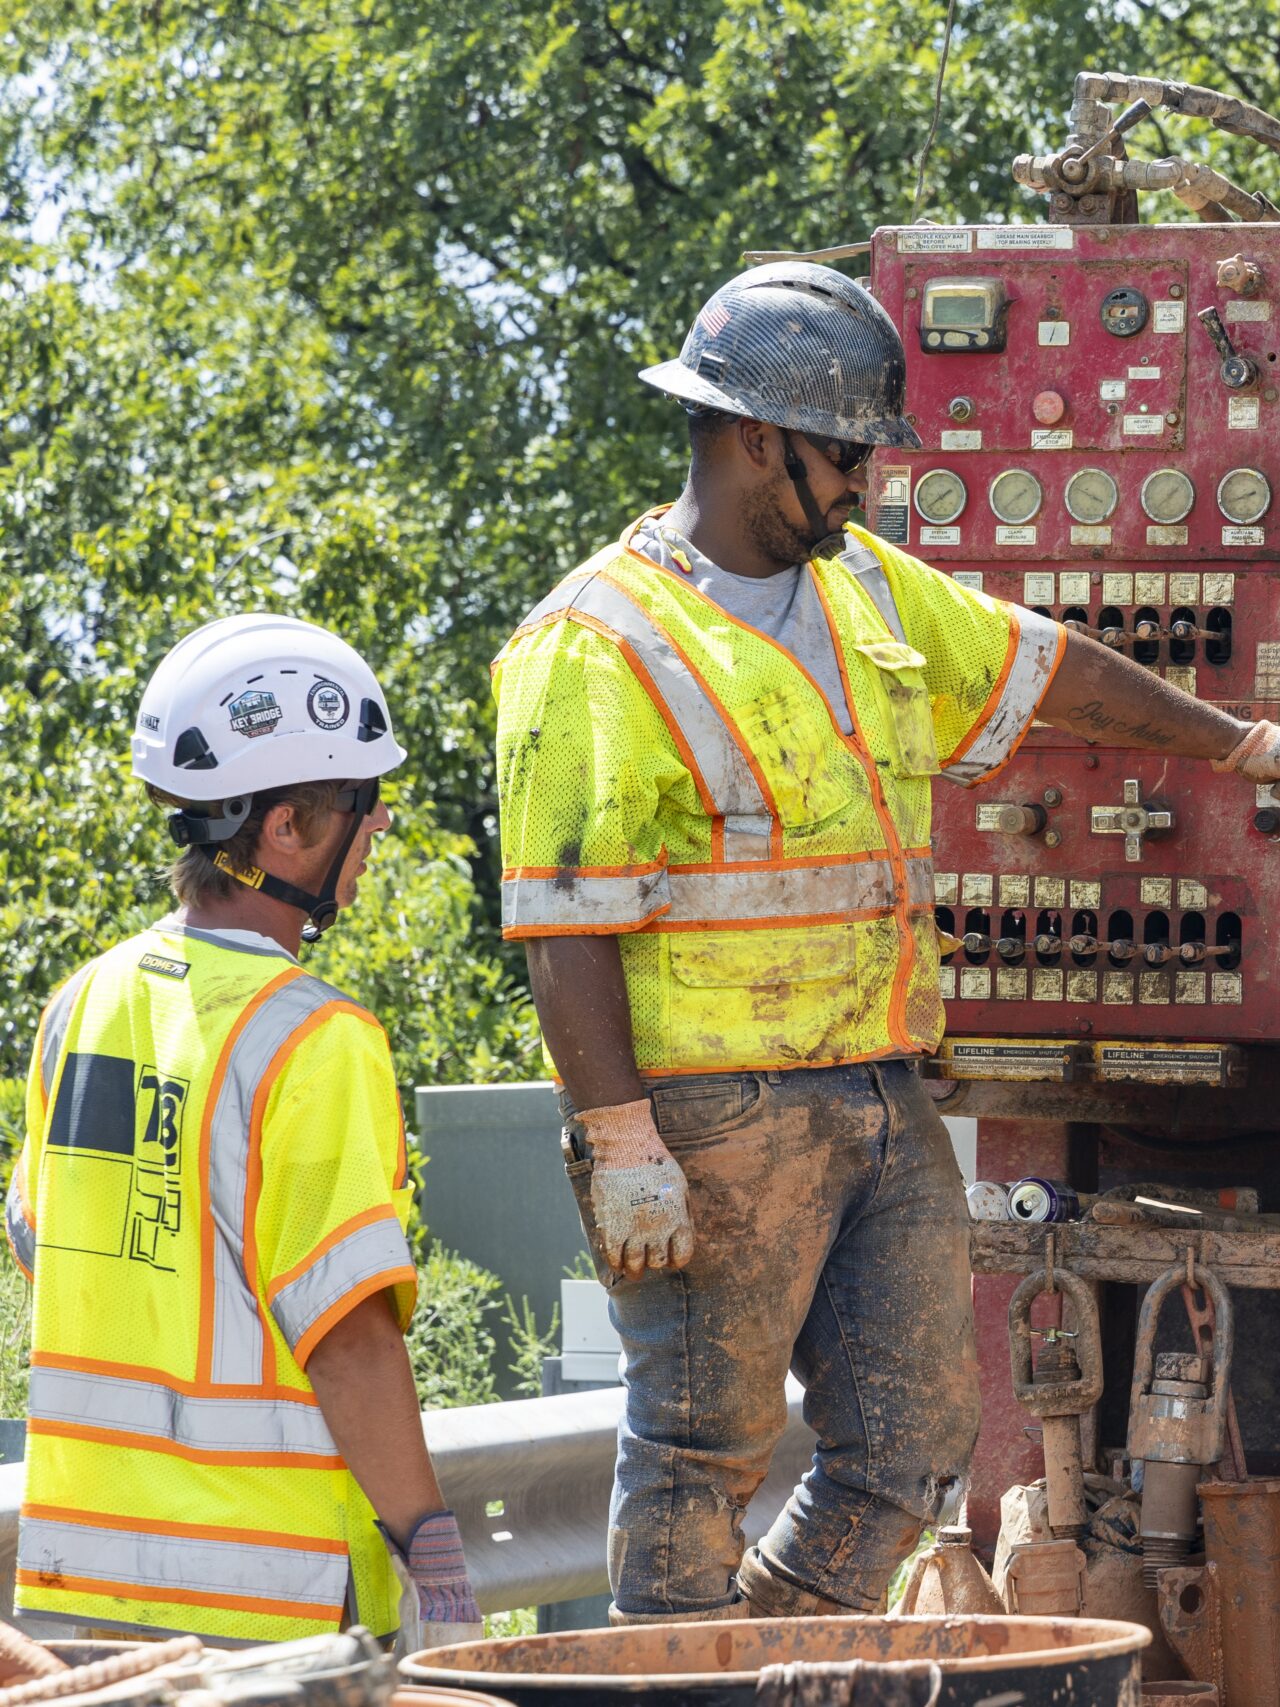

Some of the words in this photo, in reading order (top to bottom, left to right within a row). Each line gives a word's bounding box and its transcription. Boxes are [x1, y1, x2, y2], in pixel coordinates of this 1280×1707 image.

[309, 681, 345, 697] ENVIRONMENTAL
[231, 717, 249, 730] KEY
[249, 707, 282, 725] BRIDGE
[315, 718, 345, 729] TRAINED
[958, 1047, 995, 1055] LIFELINE
[1107, 1051, 1145, 1059] LIFELINE
